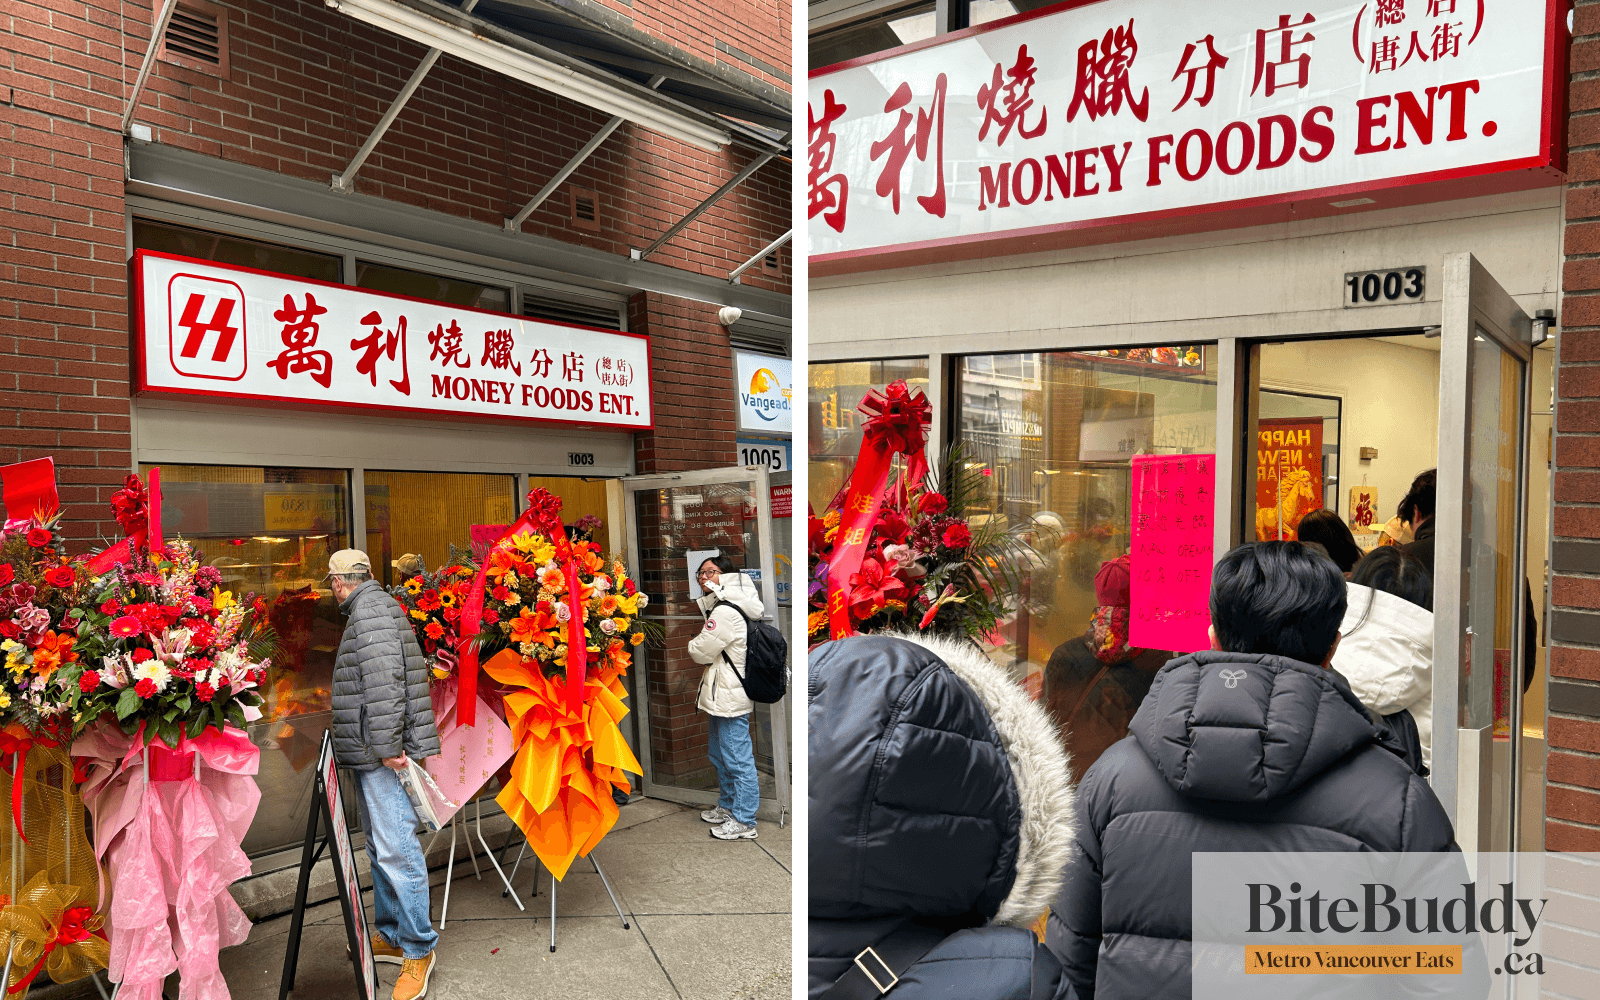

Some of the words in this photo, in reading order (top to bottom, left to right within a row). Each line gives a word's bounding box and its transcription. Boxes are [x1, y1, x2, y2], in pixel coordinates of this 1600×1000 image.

[1369, 22, 1463, 74] 唐人街
[978, 142, 1133, 211] MONEY
[1147, 106, 1335, 187] FOODS
[1354, 80, 1498, 156] ENT.
[1347, 268, 1424, 303] 1003
[431, 374, 515, 405] MONEY
[521, 384, 594, 412] FOODS
[598, 392, 641, 416] ENT.
[569, 453, 594, 465] 1003
[742, 448, 782, 470] 1005
[1355, 492, 1373, 527] 福
[1140, 542, 1166, 556] NEW
[1176, 568, 1201, 583] OFF
